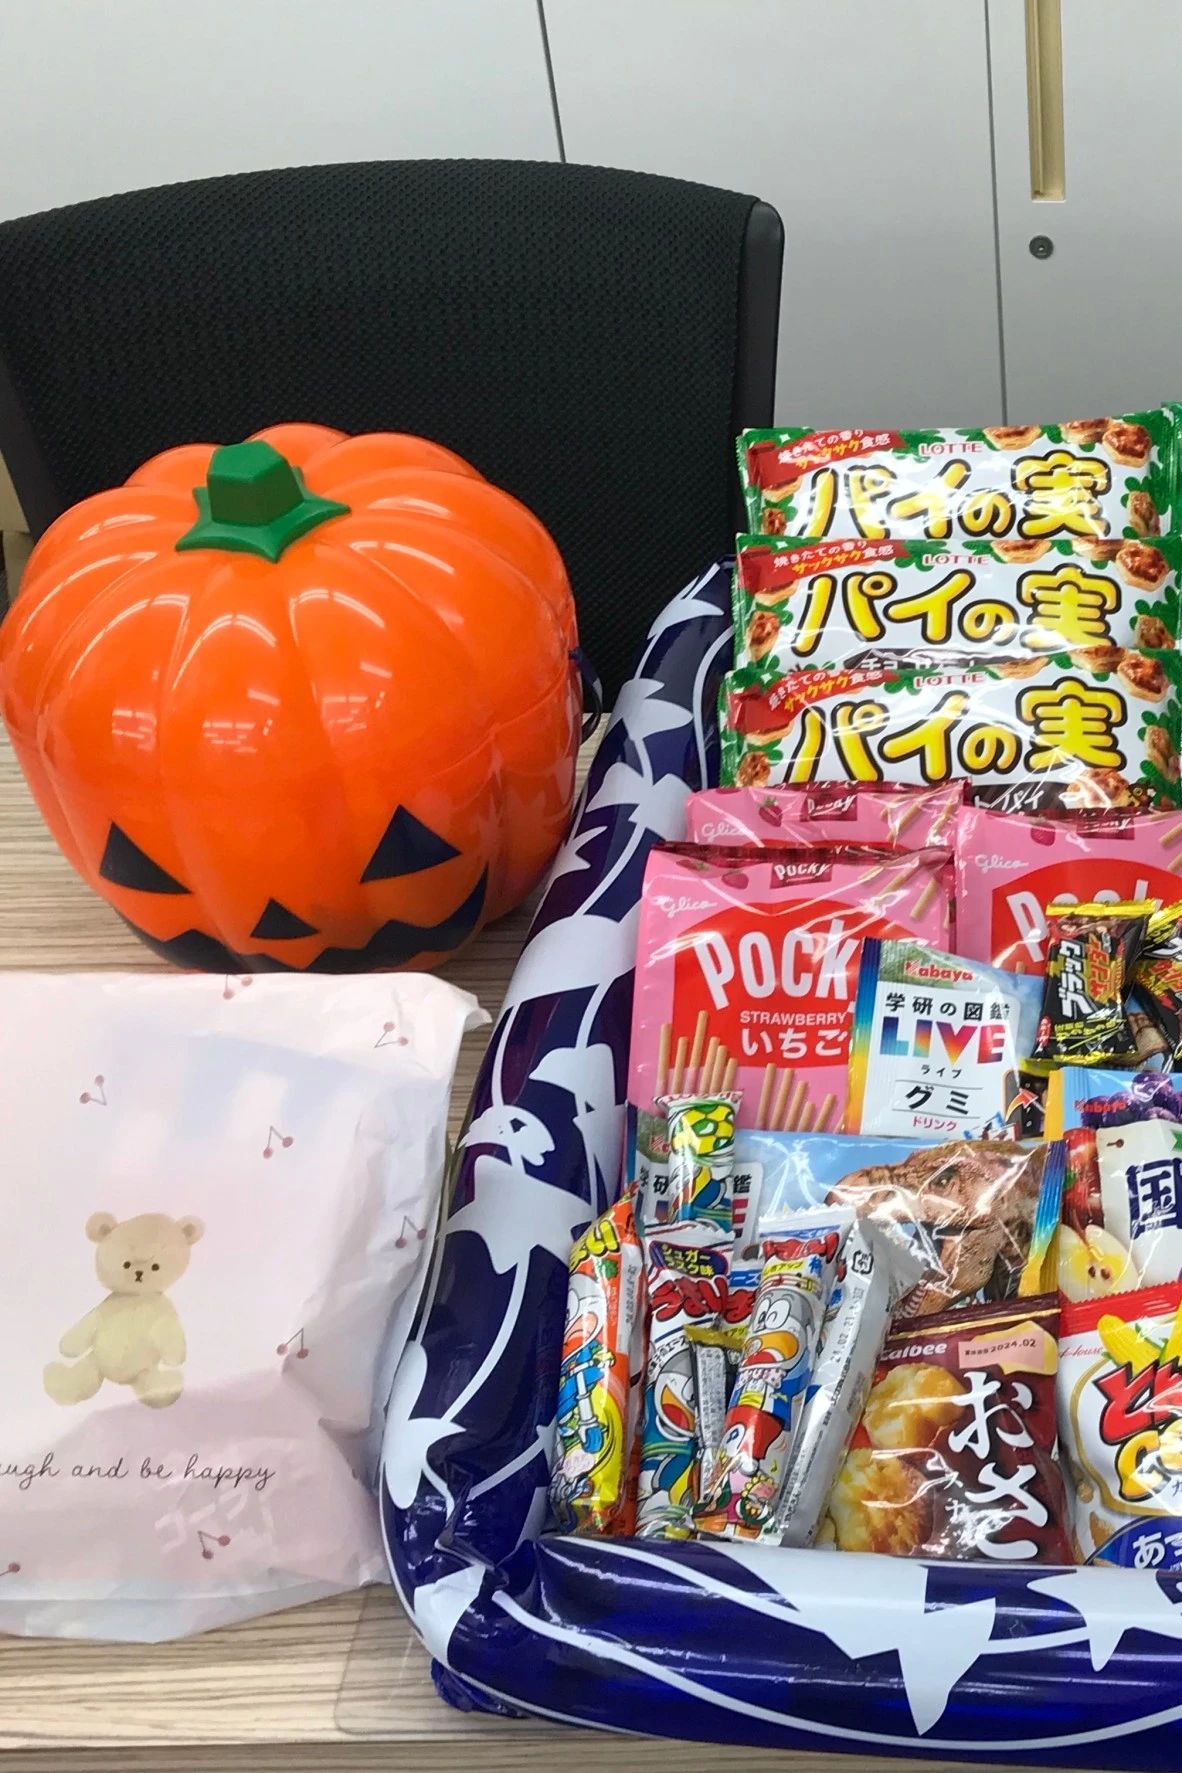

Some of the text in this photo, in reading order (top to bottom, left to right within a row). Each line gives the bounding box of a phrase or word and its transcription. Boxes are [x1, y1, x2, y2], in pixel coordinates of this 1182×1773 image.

[919, 443, 983, 455] LOTTE
[797, 450, 1112, 538] パイの実
[922, 554, 990, 566] LOTTE
[792, 563, 1122, 657] パイの実
[914, 675, 985, 687] LOTTE
[784, 677, 1128, 783] パイの実
[974, 854, 1029, 874] Glico
[658, 897, 718, 918] Glico
[690, 918, 861, 1011] POCK
[1059, 939, 1094, 1018] ブラック
[1085, 934, 1111, 1000] サンダー
[740, 1010, 847, 1026] STRAWBERRY
[885, 991, 1011, 1022] 学研の図鑑
[742, 1029, 849, 1060] いちご
[879, 1015, 1006, 1066] LIVE
[921, 1064, 963, 1080] ライブ
[905, 1085, 971, 1115] グミ
[912, 1115, 958, 1132] ドリンク
[0, 1451, 277, 1491] ugh and be happy
